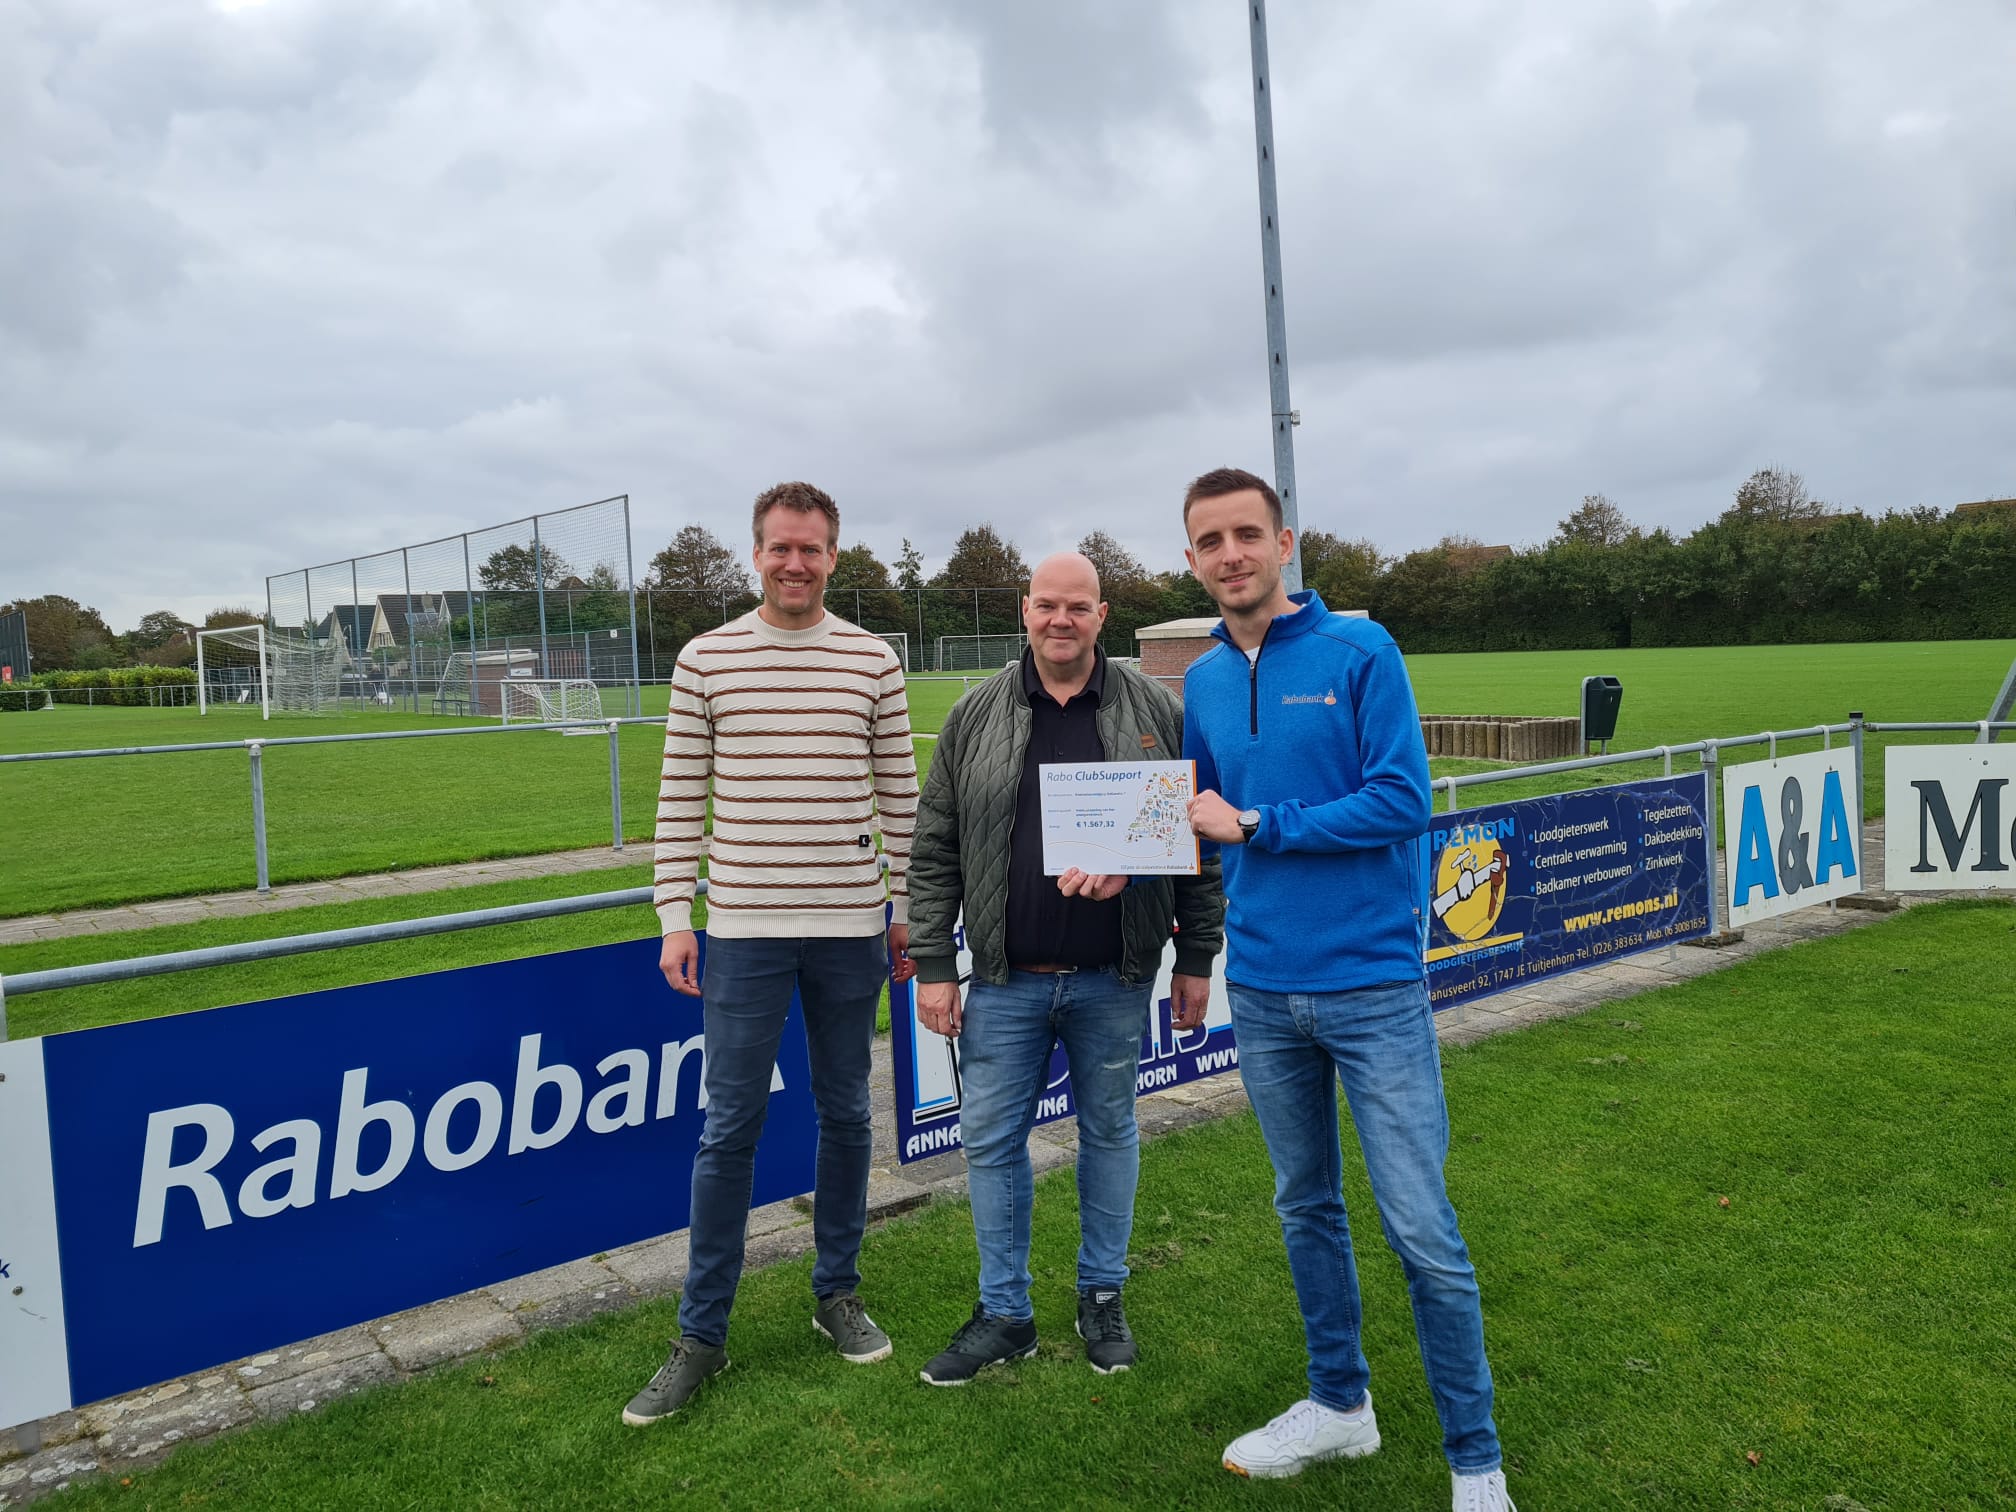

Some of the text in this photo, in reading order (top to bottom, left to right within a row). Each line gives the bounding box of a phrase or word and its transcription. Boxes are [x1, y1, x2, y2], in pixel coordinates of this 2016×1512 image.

[1047, 770, 1142, 782] Rabo ClubSupport
[1083, 820, 1115, 829] 1.567,32
[1643, 805, 1692, 824] Tegelzetten
[1433, 817, 1515, 851] REMON
[1534, 816, 1609, 843] Loodgieterswerk
[1644, 825, 1702, 847] Dakbedekking
[1733, 770, 1857, 907] A&A
[1535, 840, 1627, 869] Centrale verwarming
[1645, 851, 1684, 871] Zinkwerk
[1536, 864, 1632, 895] Badkamer verbouwen
[1564, 887, 1678, 933] www.remons.nl
[1478, 974, 1492, 988] 92,
[1495, 968, 1514, 982] 1747
[1516, 964, 1526, 977] JE
[1527, 953, 1575, 973] Tuitjenhorn
[1576, 946, 1591, 960] Tel.
[1593, 941, 1613, 956] 0226
[1646, 928, 1664, 941] Mob.
[133, 1017, 786, 1248] Raboban
